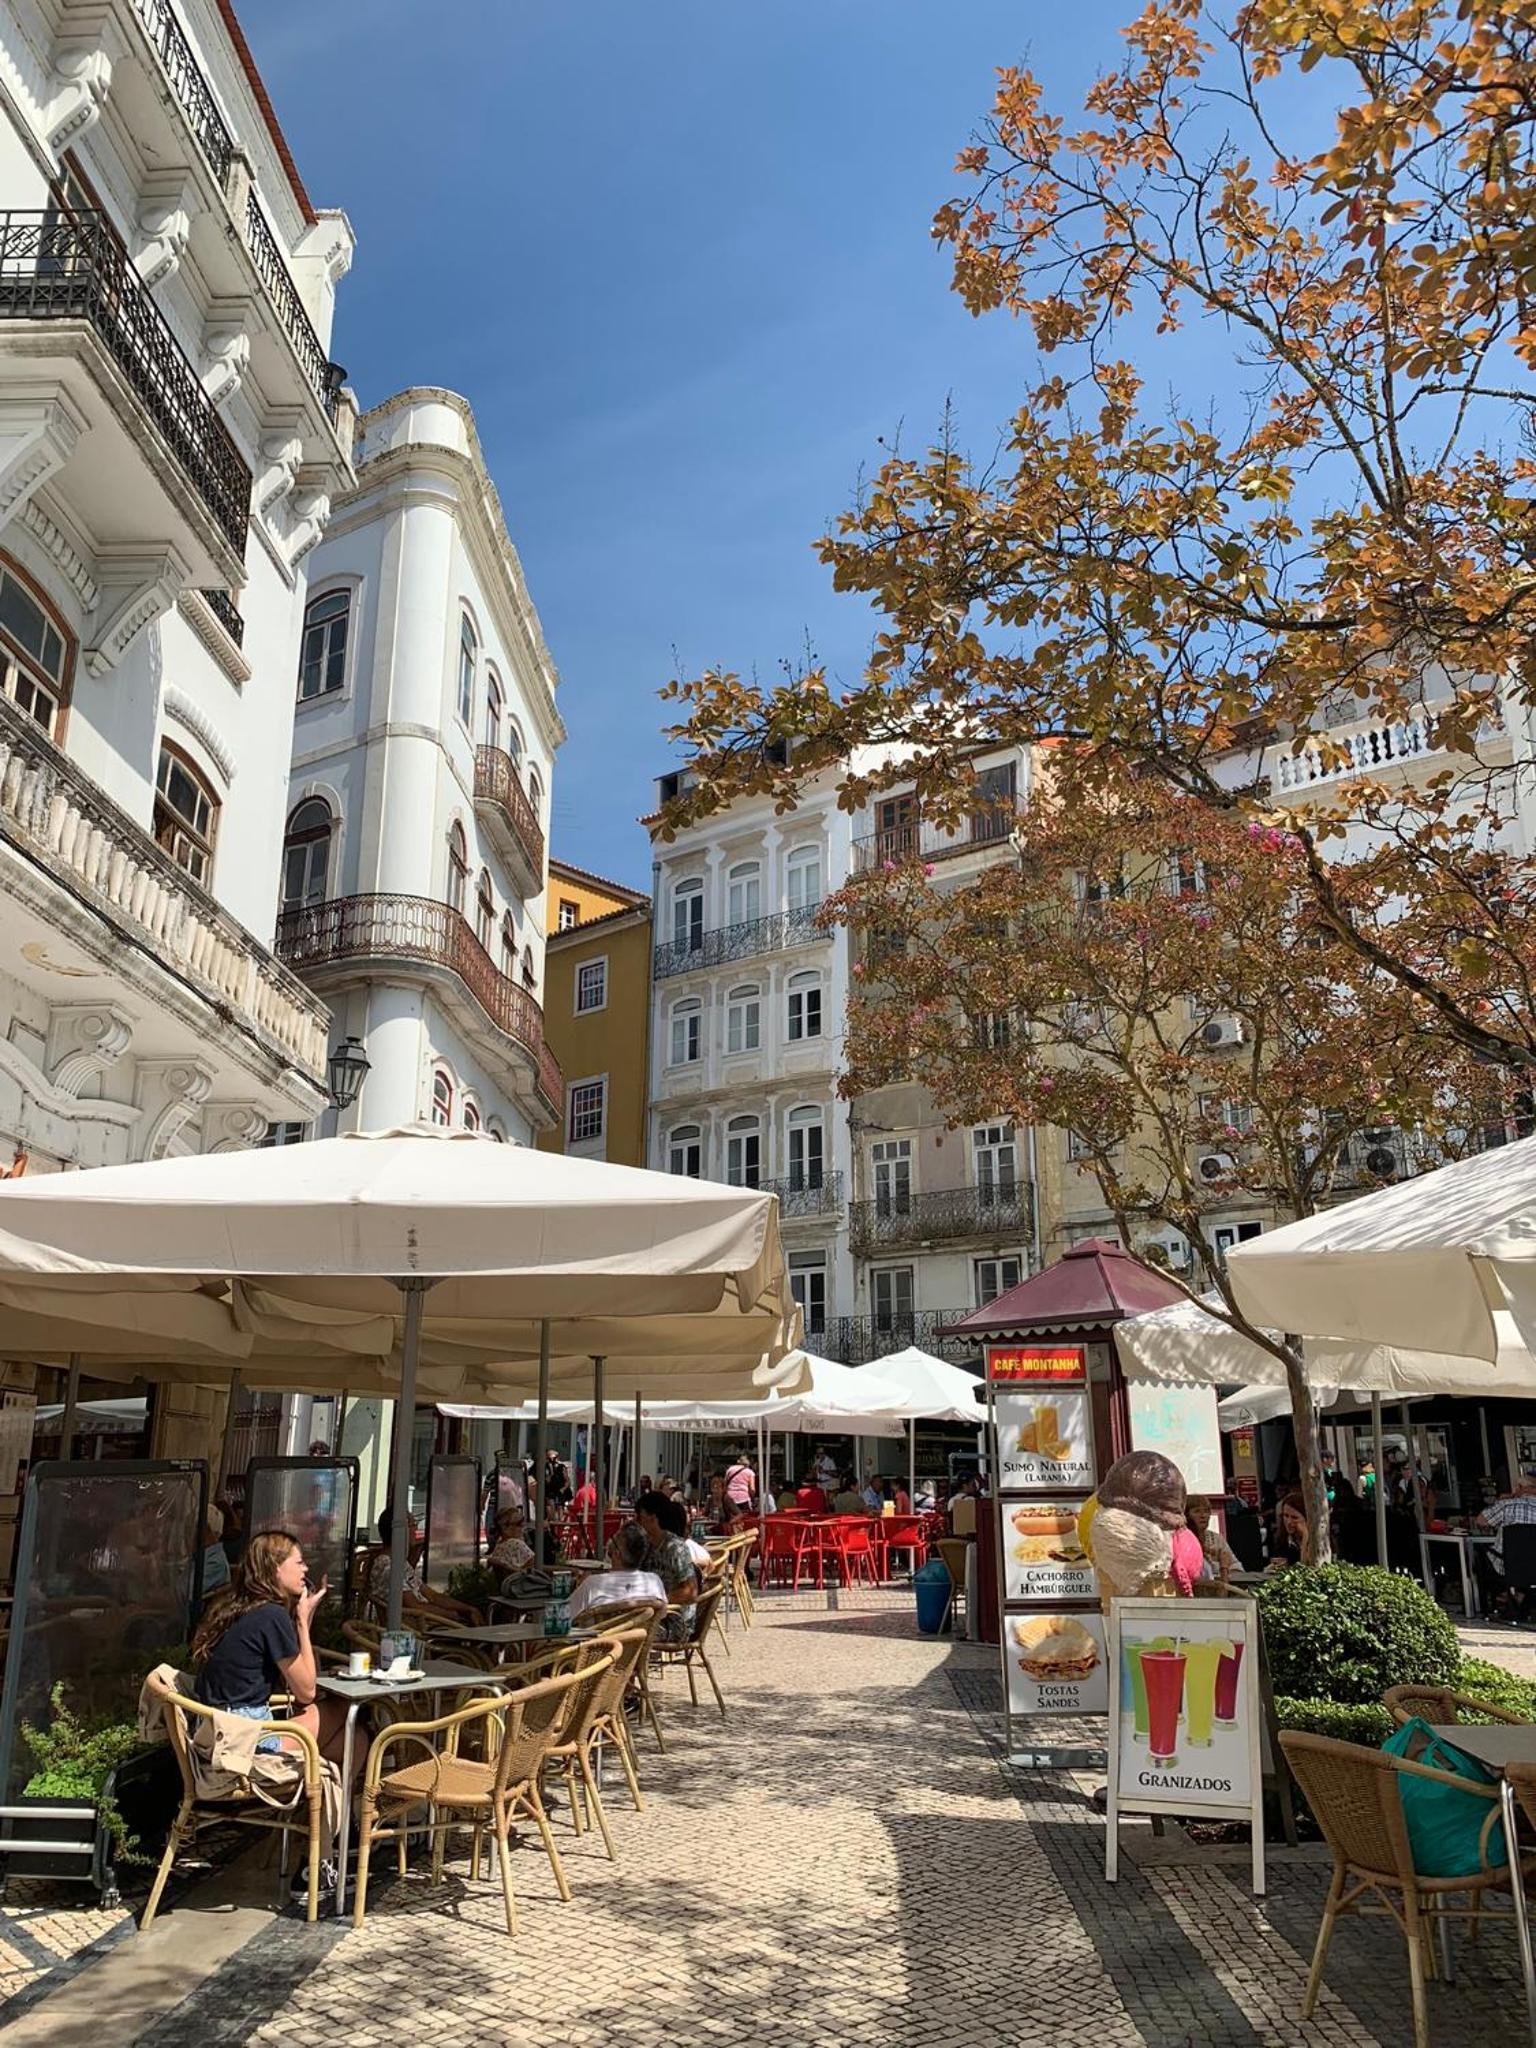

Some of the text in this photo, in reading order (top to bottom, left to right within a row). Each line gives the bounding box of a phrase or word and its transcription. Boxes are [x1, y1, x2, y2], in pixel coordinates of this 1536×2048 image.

[1022, 1358, 1081, 1371] MONTANHA
[1027, 1571, 1084, 1581] CACHORRO
[1038, 1684, 1080, 1695] TOSTAS
[1037, 1696, 1080, 1708] SANDES
[1138, 1771, 1232, 1791] GRANIZADOS
